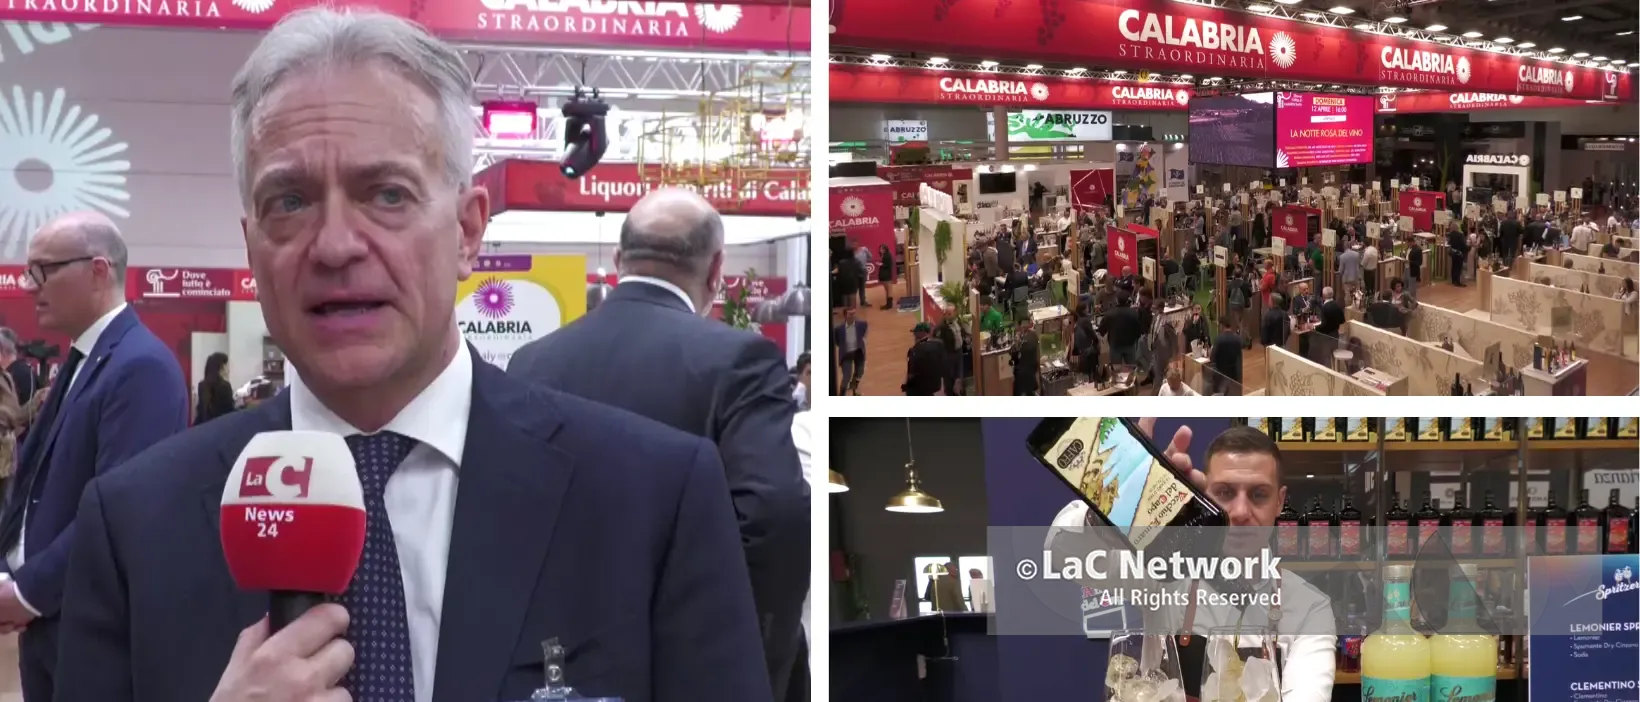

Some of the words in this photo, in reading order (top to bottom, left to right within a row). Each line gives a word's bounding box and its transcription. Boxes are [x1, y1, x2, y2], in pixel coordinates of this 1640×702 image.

[477, 12, 689, 36] STRAORDINARIA
[1118, 9, 1264, 55] CALABRIA
[1119, 43, 1264, 69] STRAORDINARIA
[1381, 46, 1455, 74] CALABRIA
[1381, 70, 1455, 85] STRAORDINARIA
[1519, 65, 1563, 86] CALABRIA
[940, 77, 1028, 95] CALABRIA
[1112, 86, 1174, 100] CALABRIA
[940, 93, 1028, 102] STRAORDINARIA
[1449, 92, 1508, 104] CALABRIA
[1044, 113, 1108, 126] ABRUZZO
[1290, 129, 1299, 138] LA
[1299, 129, 1320, 138] NOTTE
[1320, 129, 1338, 137] ROSA
[1338, 129, 1348, 137] DEL
[1348, 128, 1363, 137] VINO
[579, 176, 650, 202] Liquori
[182, 270, 206, 279] Dove
[182, 279, 204, 287] tutto
[182, 288, 231, 296] cominciato
[1164, 482, 1178, 498] del
[1147, 494, 1168, 517] Capo
[1158, 491, 1189, 518] Vecchio
[245, 507, 294, 522] News
[257, 523, 278, 538] 24
[1570, 622, 1622, 633] LEMONIER
[1603, 642, 1614, 650] Dry
[1615, 641, 1638, 649] Cinzano
[1570, 680, 1636, 691] CLEMENTINO
